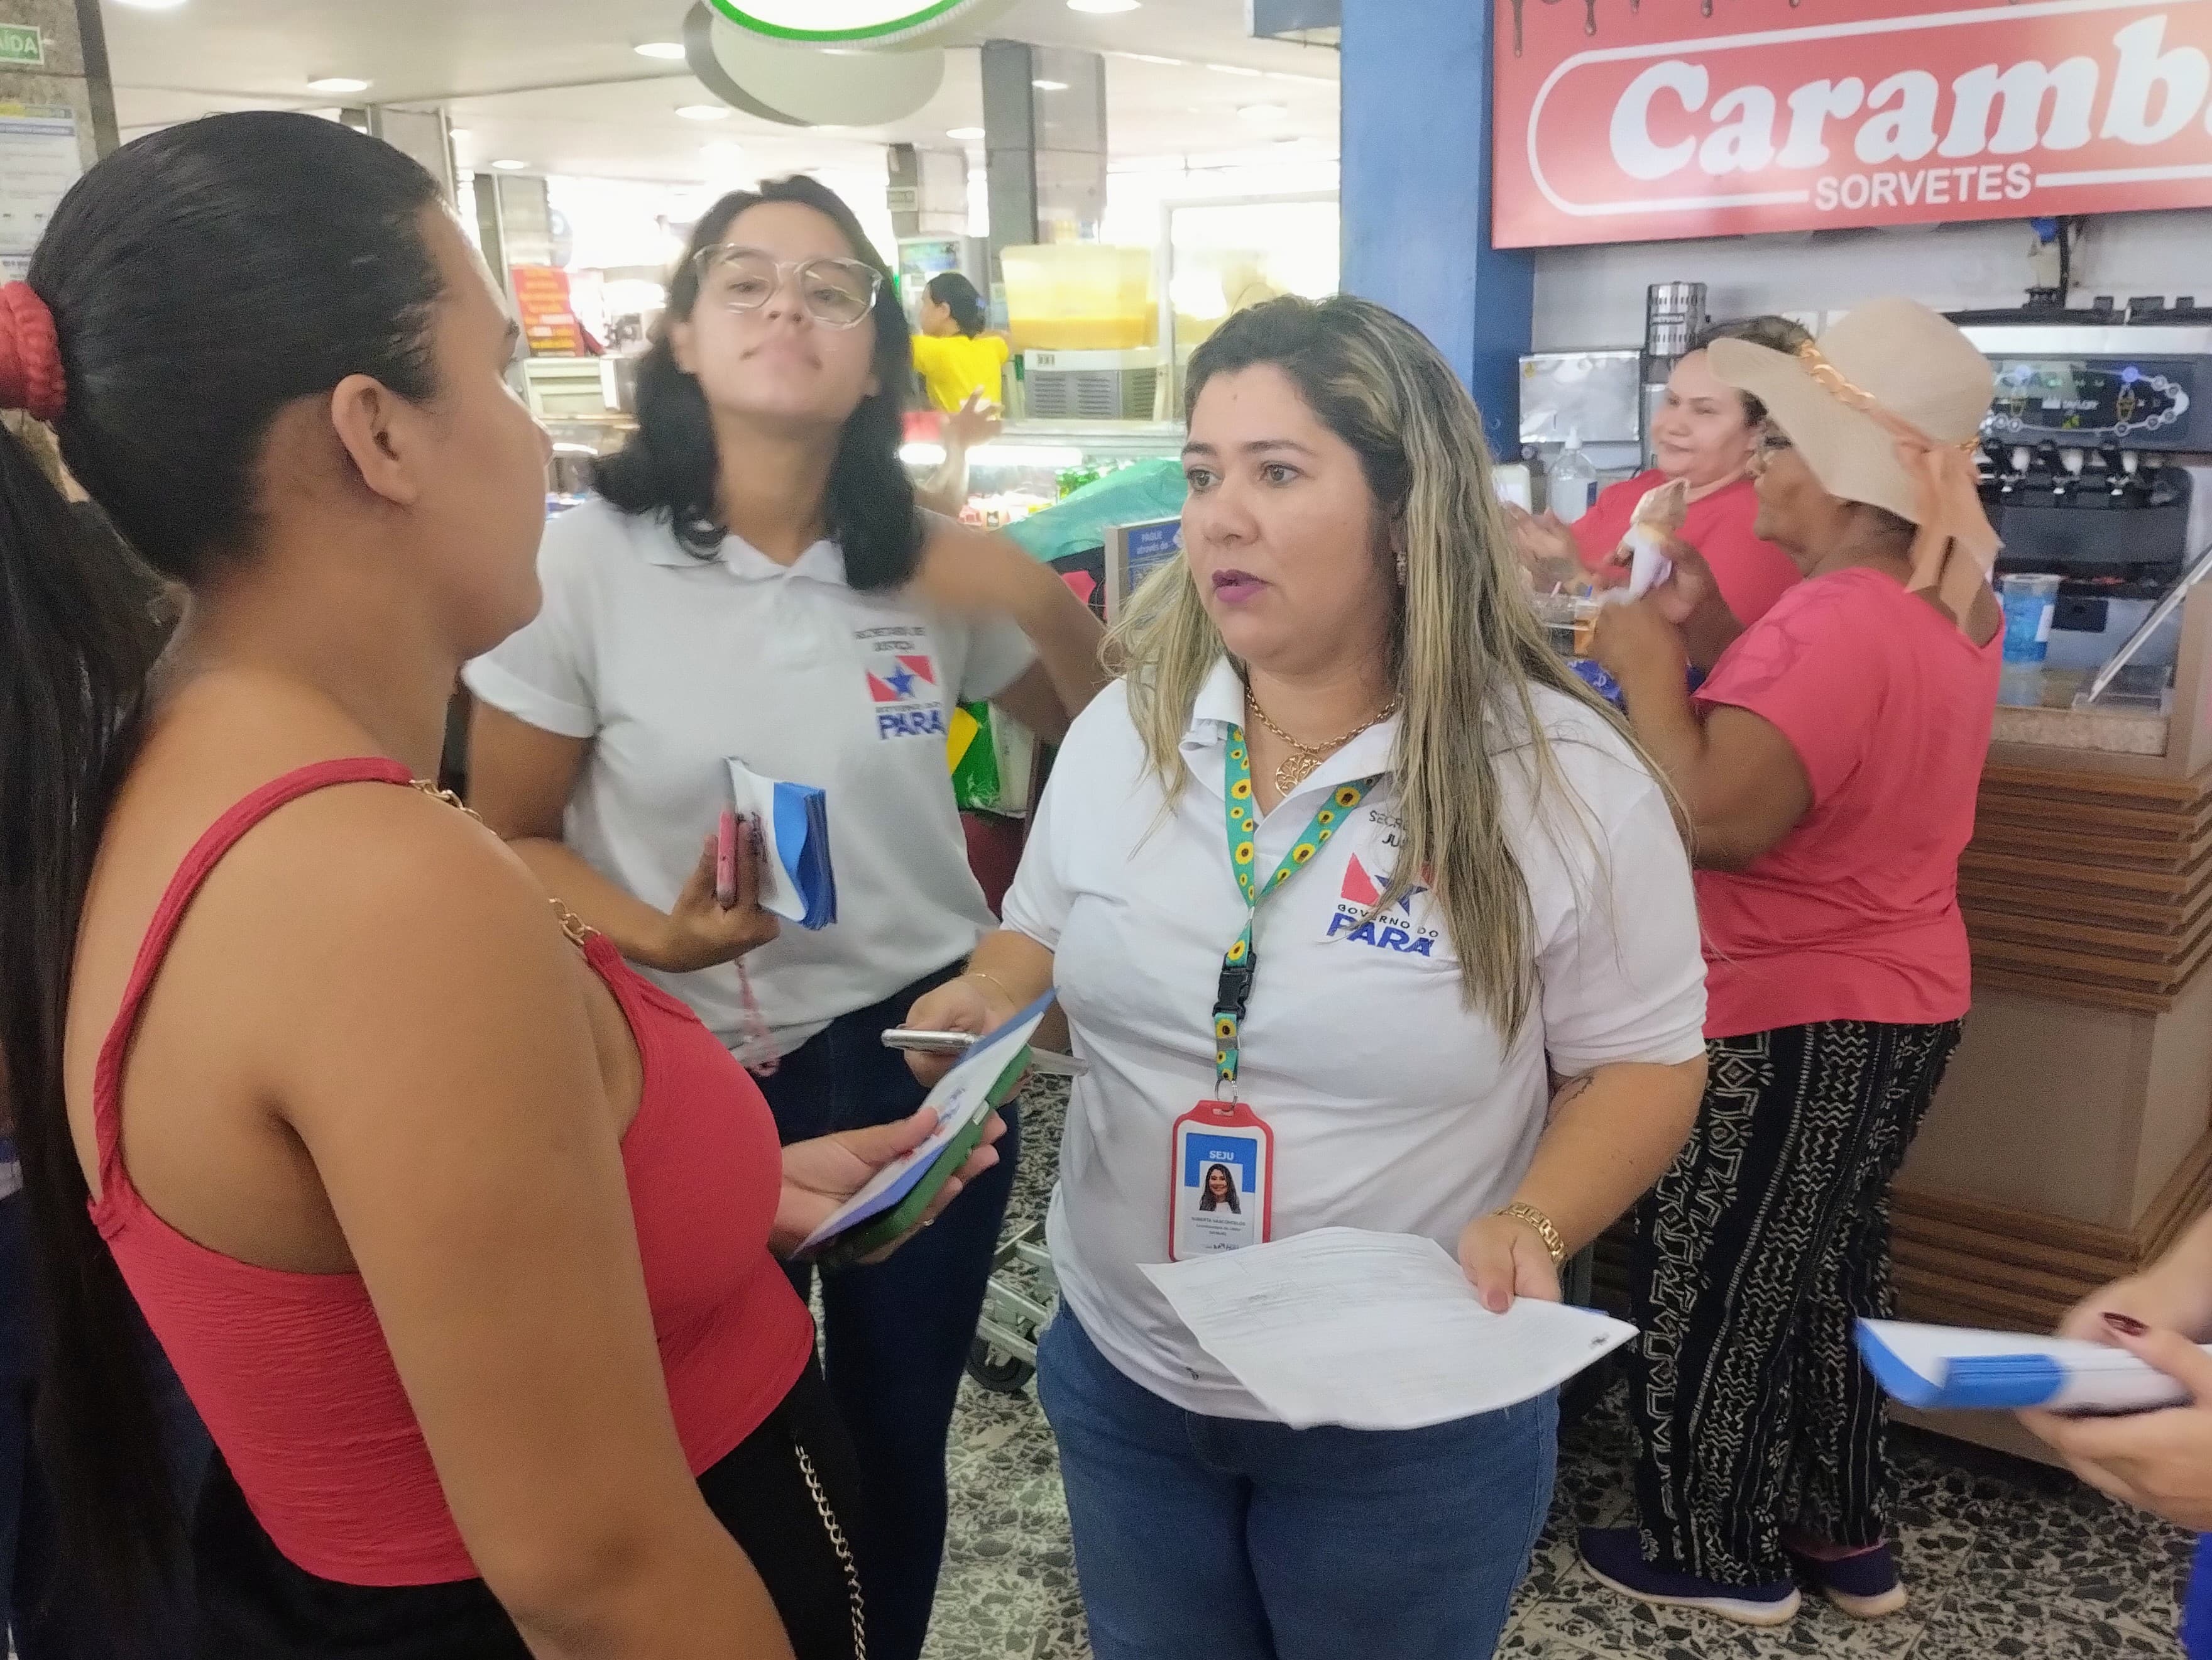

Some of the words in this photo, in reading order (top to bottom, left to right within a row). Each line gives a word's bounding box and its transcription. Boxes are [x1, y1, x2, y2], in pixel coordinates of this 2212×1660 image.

[1609, 14, 2212, 180] Caramb
[1814, 163, 2032, 211] SORVETES
[1337, 904, 1411, 929] GOVRNO
[1416, 926, 1439, 938] DO
[1209, 1150, 1234, 1160] SEJU
